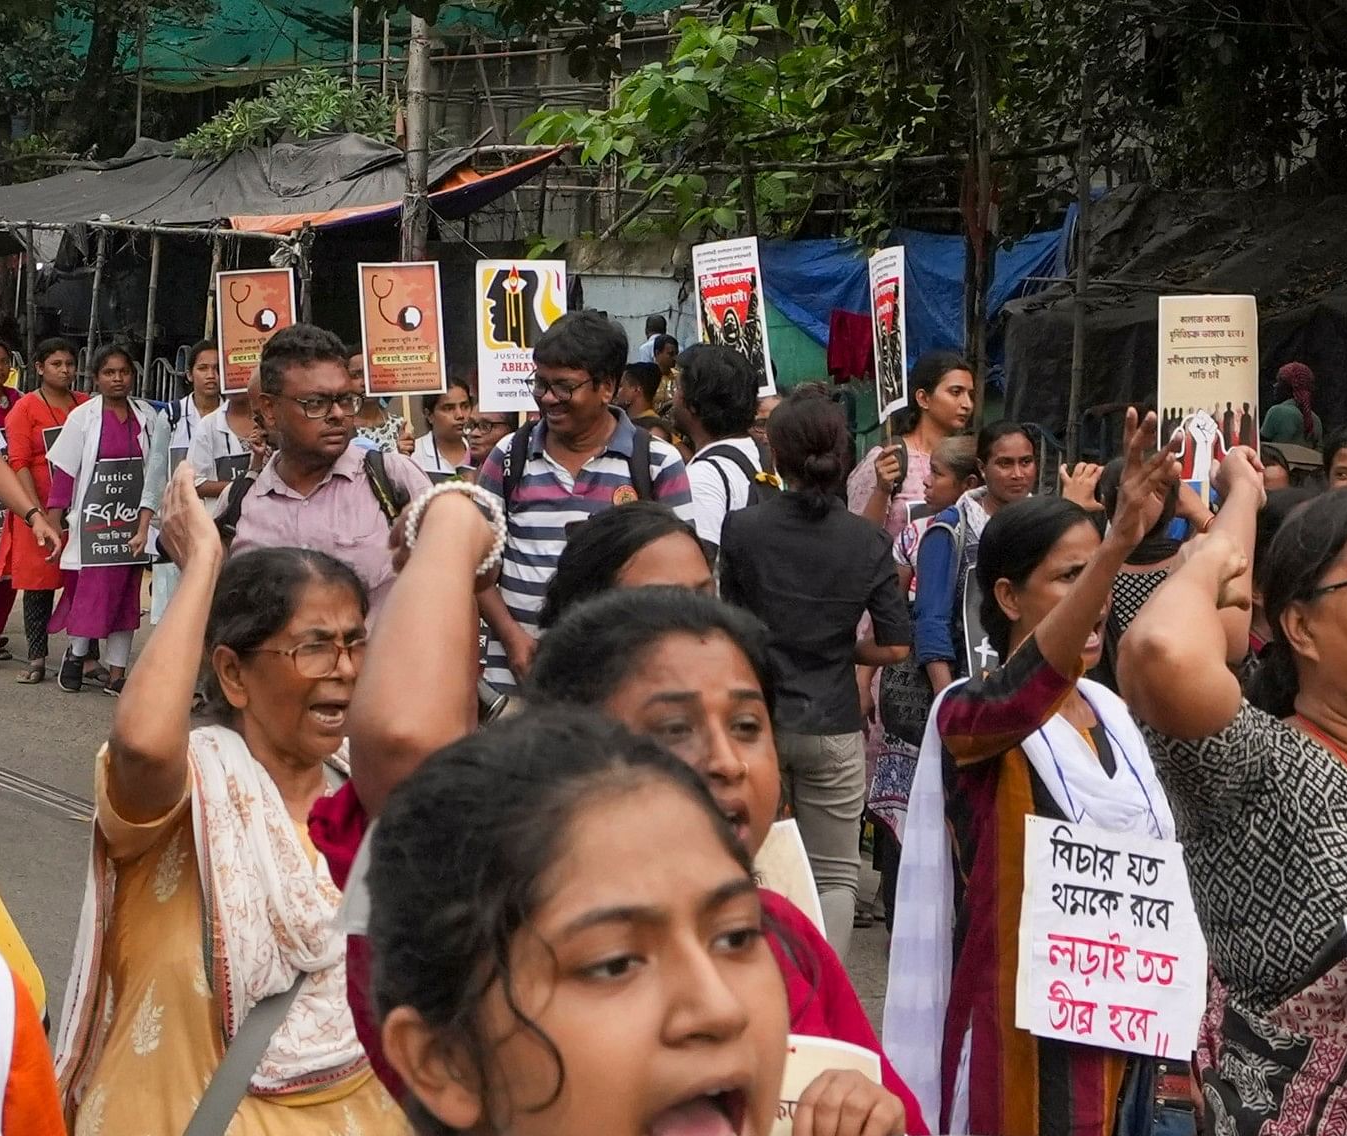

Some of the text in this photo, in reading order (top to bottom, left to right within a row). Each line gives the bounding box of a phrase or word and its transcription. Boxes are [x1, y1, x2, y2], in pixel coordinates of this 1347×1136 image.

[501, 363, 537, 371] ABHAY
[93, 471, 133, 485] Justice
[105, 484, 123, 495] for
[83, 502, 114, 526] RG
[92, 543, 131, 556] বিচার চা
[1050, 825, 1165, 886] বিচার যত
[1052, 883, 1174, 931] থমকে রবে
[1047, 930, 1178, 987] লড়াই তত
[1048, 980, 1097, 1035] তীব্র
